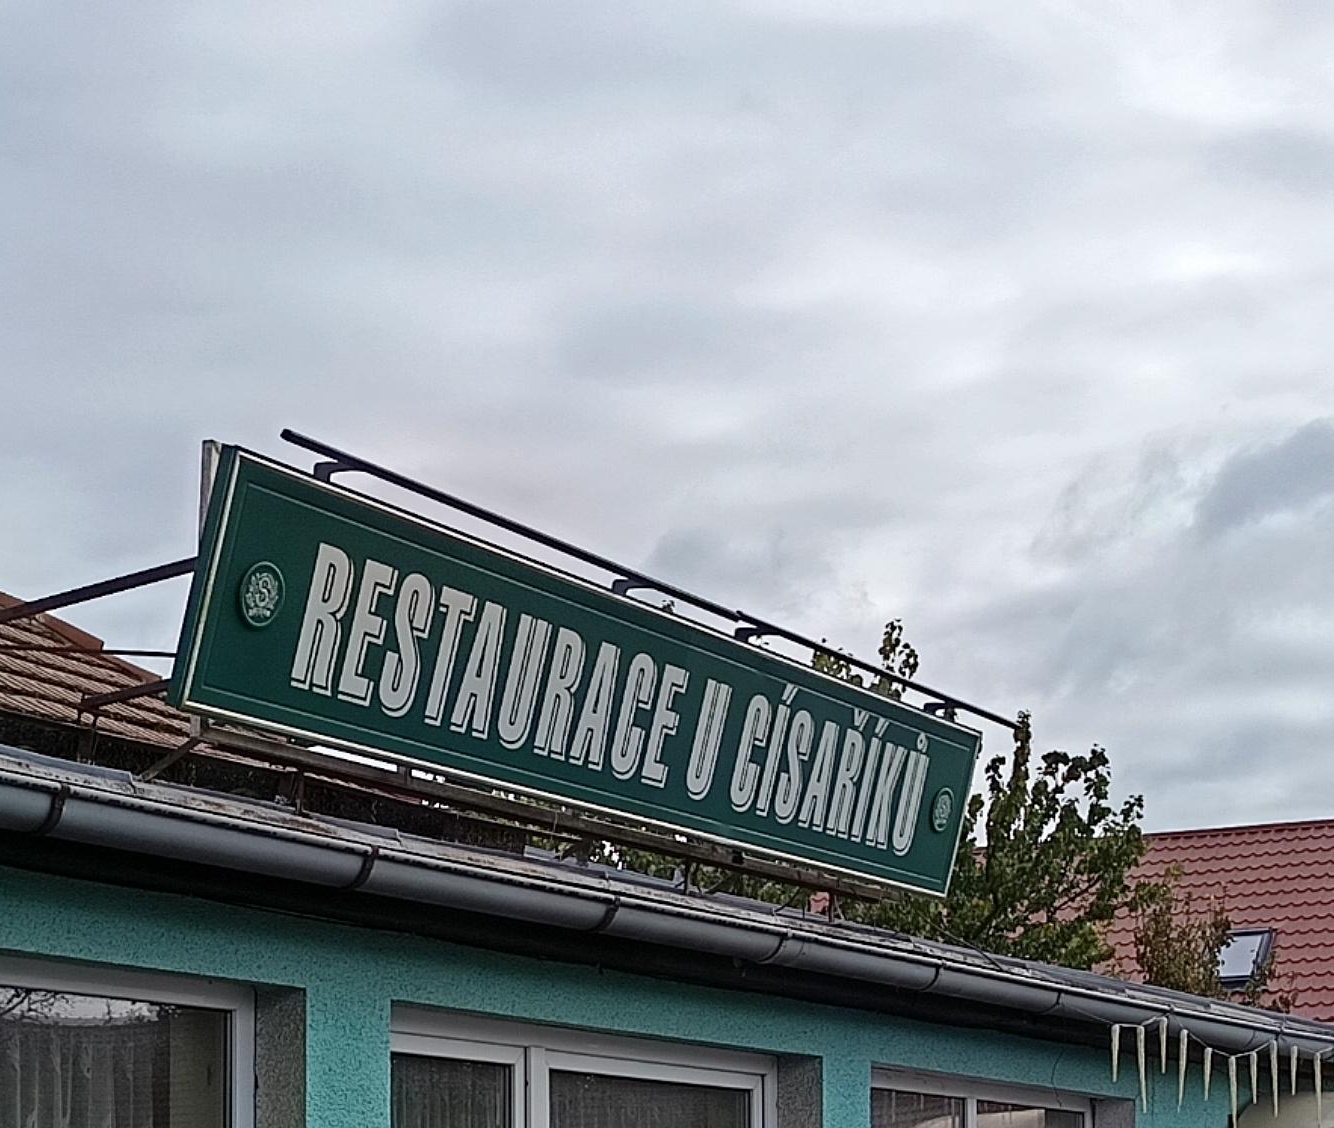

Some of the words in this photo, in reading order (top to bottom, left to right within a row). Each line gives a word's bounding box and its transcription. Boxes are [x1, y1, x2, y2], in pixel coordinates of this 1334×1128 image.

[290, 543, 689, 789] RESTAURACE
[687, 679, 732, 800] U
[730, 684, 929, 856] CÍSAŘÍKŮ
